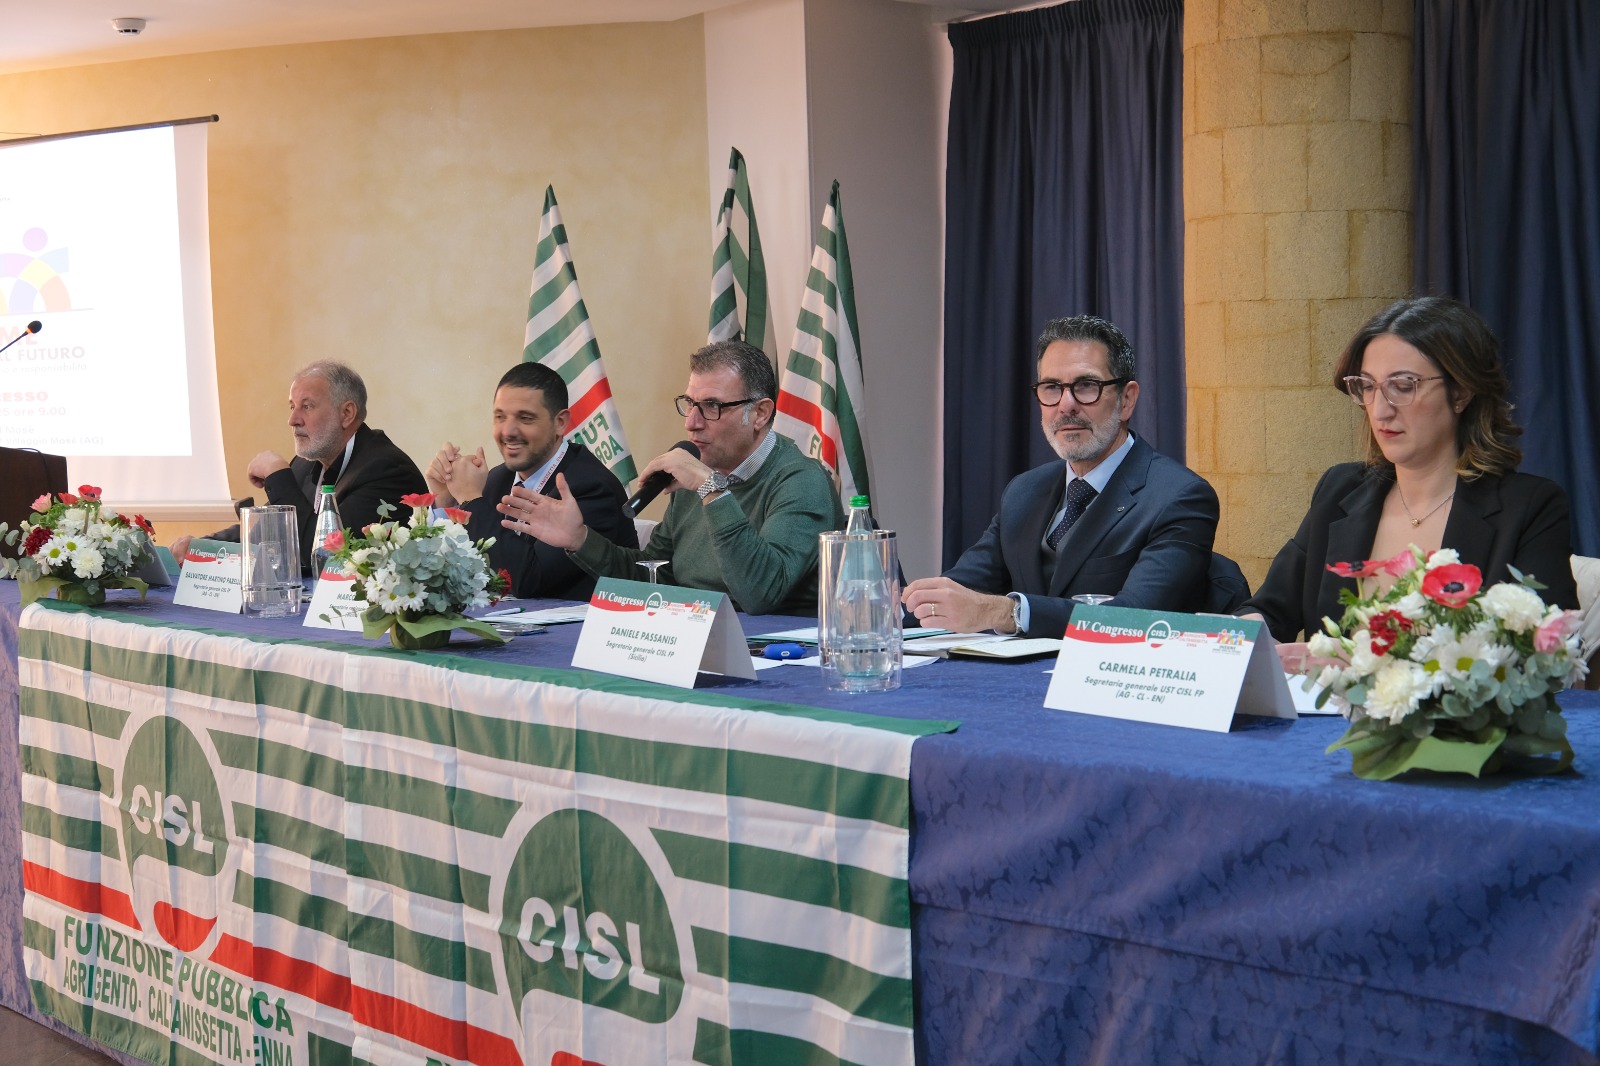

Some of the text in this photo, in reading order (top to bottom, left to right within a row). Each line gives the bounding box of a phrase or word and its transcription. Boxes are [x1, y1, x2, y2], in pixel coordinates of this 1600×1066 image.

[18, 346, 85, 362] FUTURO
[0, 391, 49, 402] ESSO
[13, 408, 35, 416] ore
[38, 406, 66, 416] 9.00
[80, 436, 104, 446] (AG)
[597, 590, 644, 607] IV Congresso
[648, 599, 660, 607] CISL
[610, 626, 678, 645] DANIELE PASSANISI
[1075, 620, 1143, 638] IV Congresso
[1150, 629, 1179, 639] CISL FP
[656, 648, 667, 657] CISL
[1099, 661, 1197, 682] CARMELA PETRALIA
[1084, 675, 1205, 698] Segretaria generale UST CISL FP
[1115, 690, 1130, 699] (AG
[1136, 692, 1146, 701] CL
[1151, 694, 1166, 704] EN)
[128, 784, 215, 855] CISL
[516, 896, 661, 995] CISL
[63, 914, 294, 1037] FUNZIONE PUBBLICA
